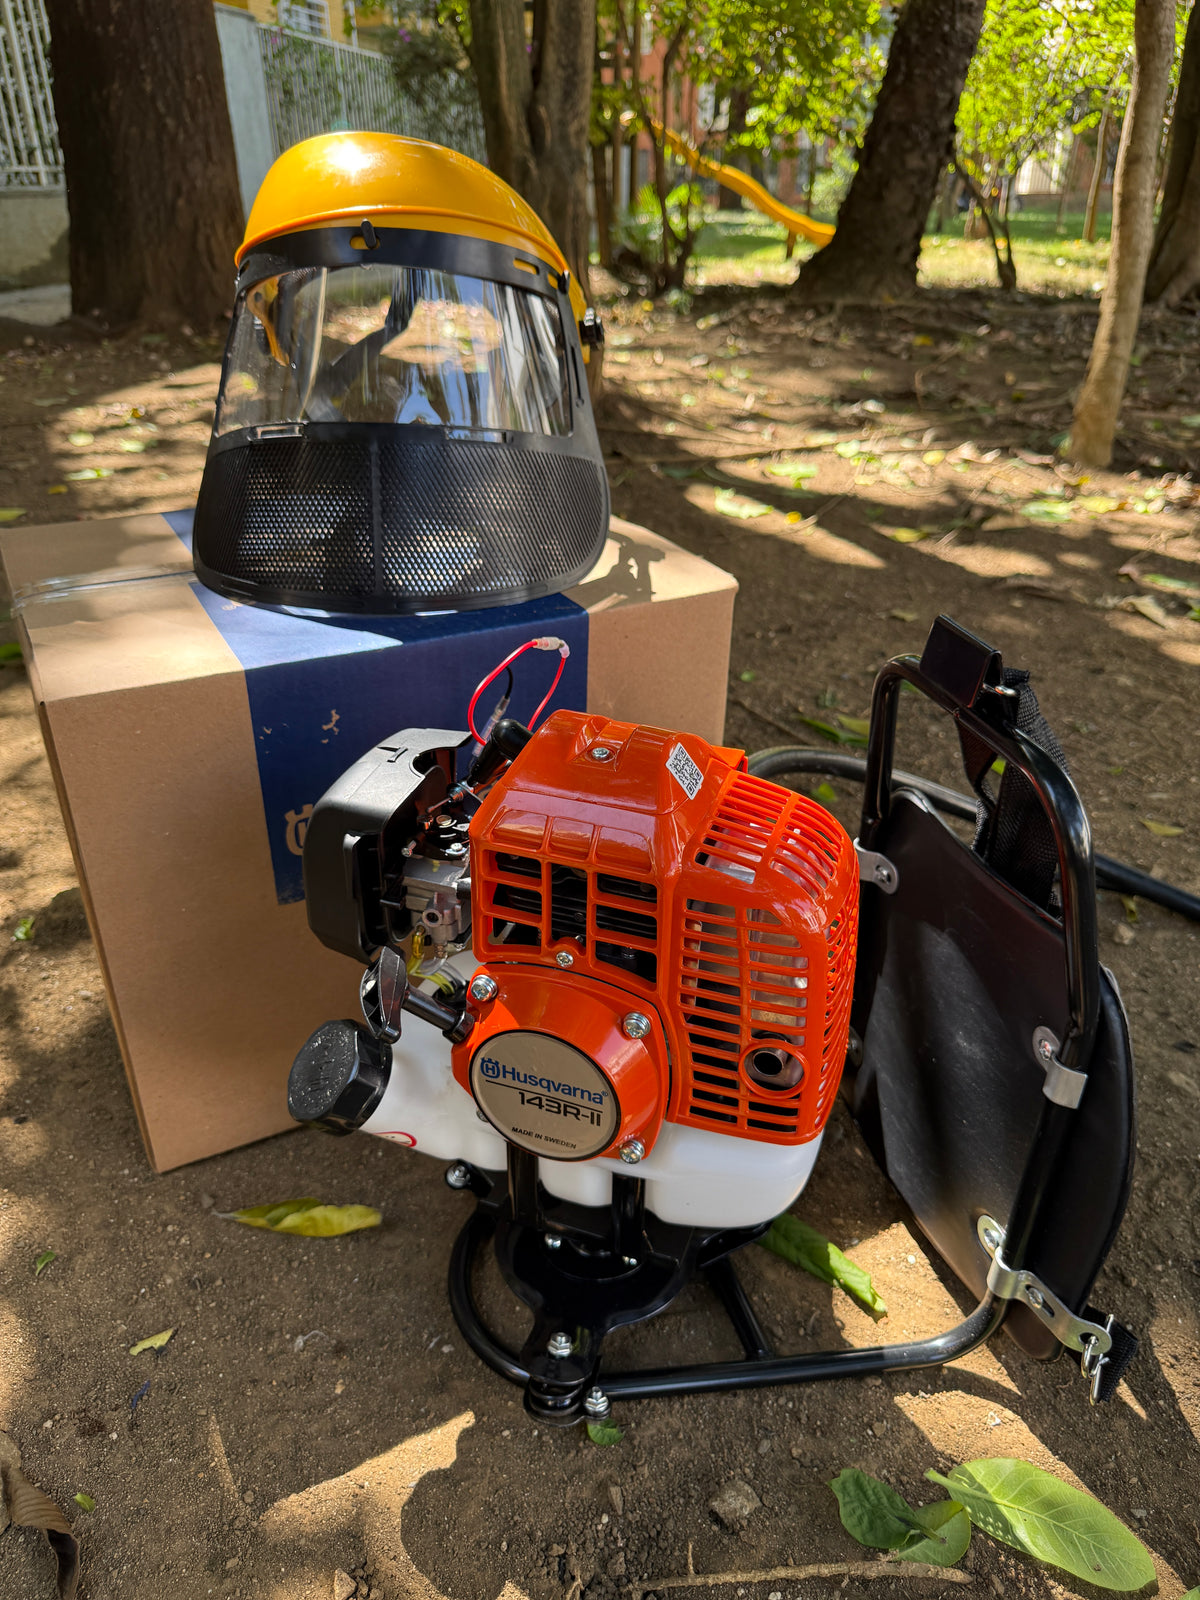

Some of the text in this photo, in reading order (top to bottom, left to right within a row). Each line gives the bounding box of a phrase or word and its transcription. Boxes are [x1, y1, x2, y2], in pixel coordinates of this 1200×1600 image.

[518, 1091, 601, 1127] 143R-II
[511, 1126, 534, 1137] MADE
[544, 1135, 577, 1150] SWEDEN
